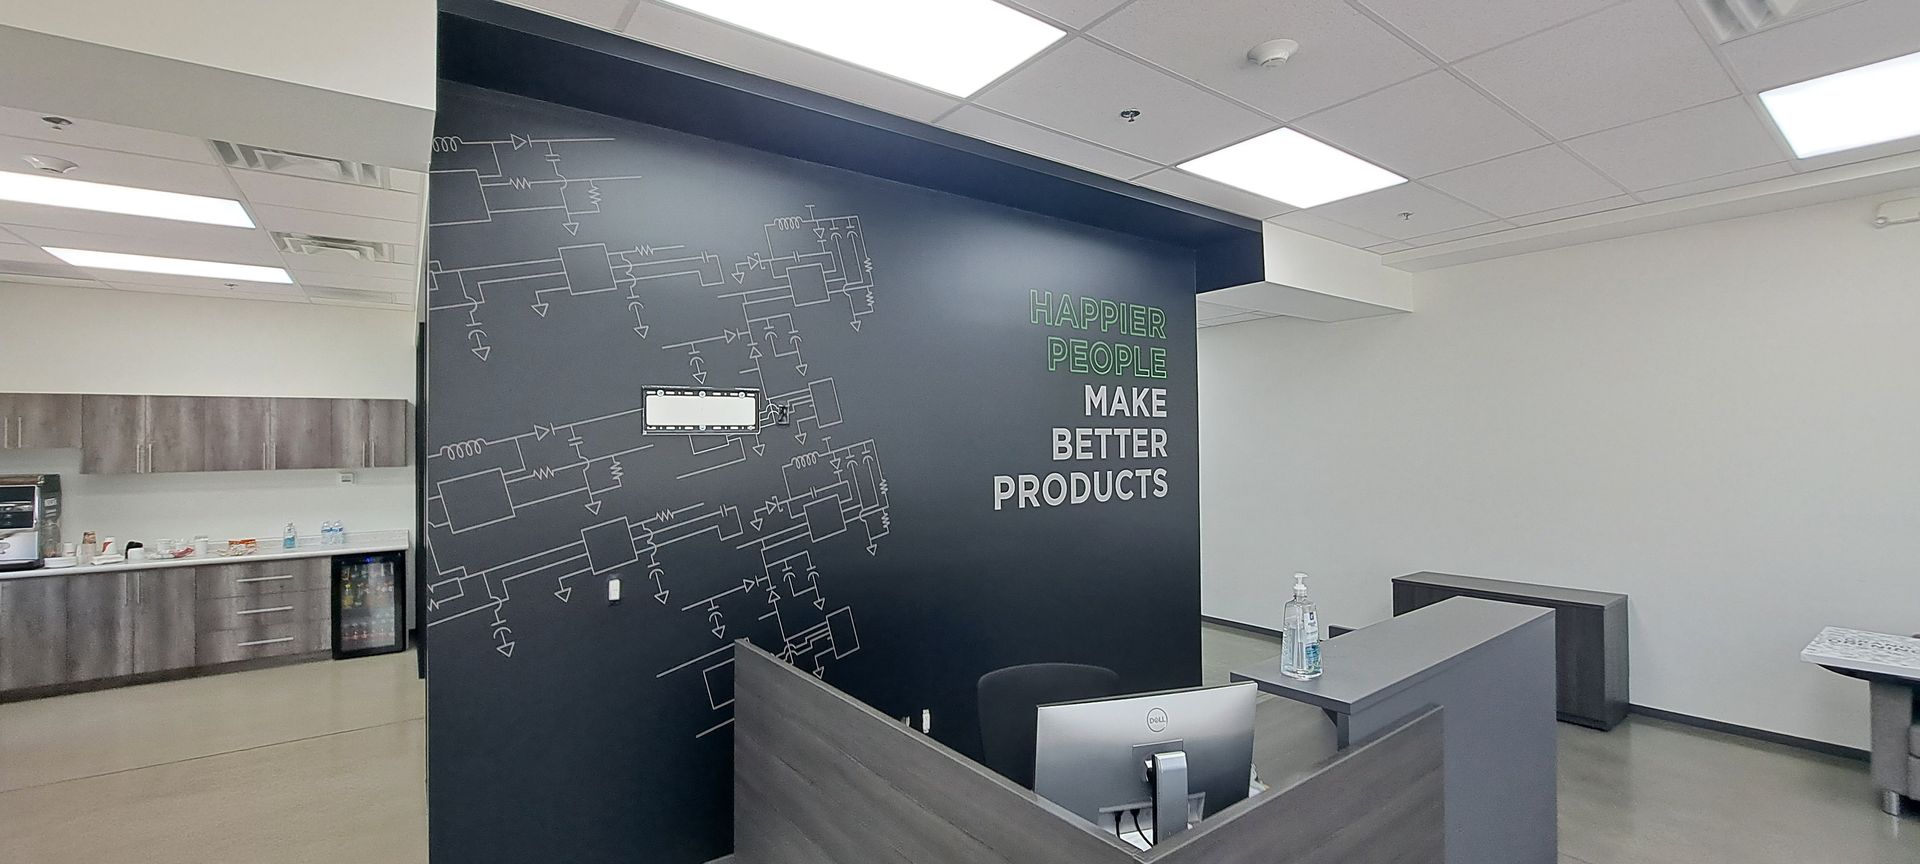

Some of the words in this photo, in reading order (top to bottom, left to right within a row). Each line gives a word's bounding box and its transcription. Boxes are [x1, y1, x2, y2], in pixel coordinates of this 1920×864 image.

[1030, 289, 1167, 339] HAPPIER
[1047, 336, 1168, 379] PEOPLE
[1084, 384, 1168, 418] MAKE
[1052, 427, 1168, 461] BETTER
[993, 468, 1169, 511] PRODUCTS
